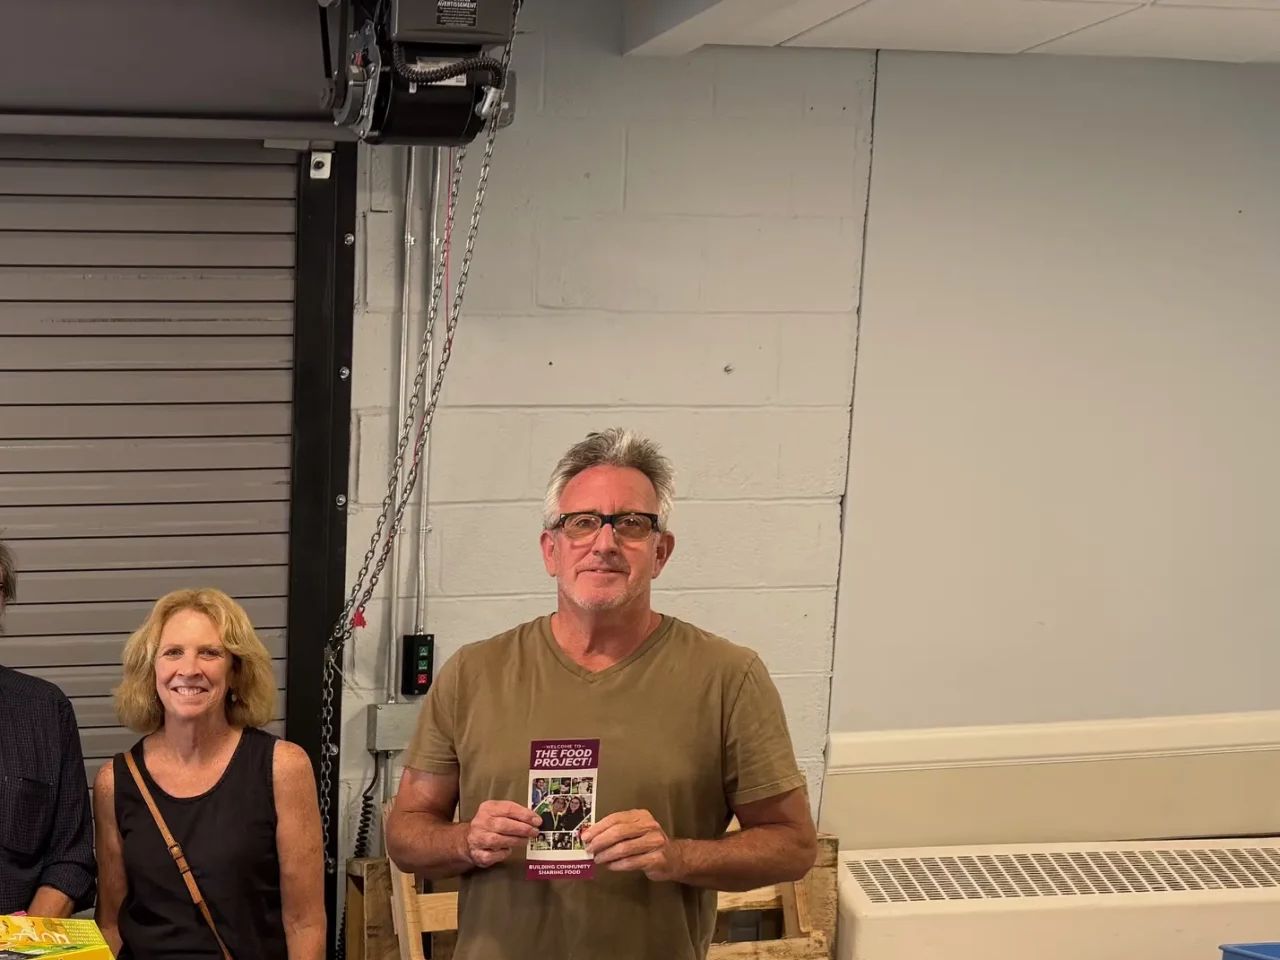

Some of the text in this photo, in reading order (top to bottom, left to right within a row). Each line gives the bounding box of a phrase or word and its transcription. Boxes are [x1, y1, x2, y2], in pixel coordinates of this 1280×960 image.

[536, 749, 592, 758] THE FOOD
[534, 757, 592, 767] PROJECT!
